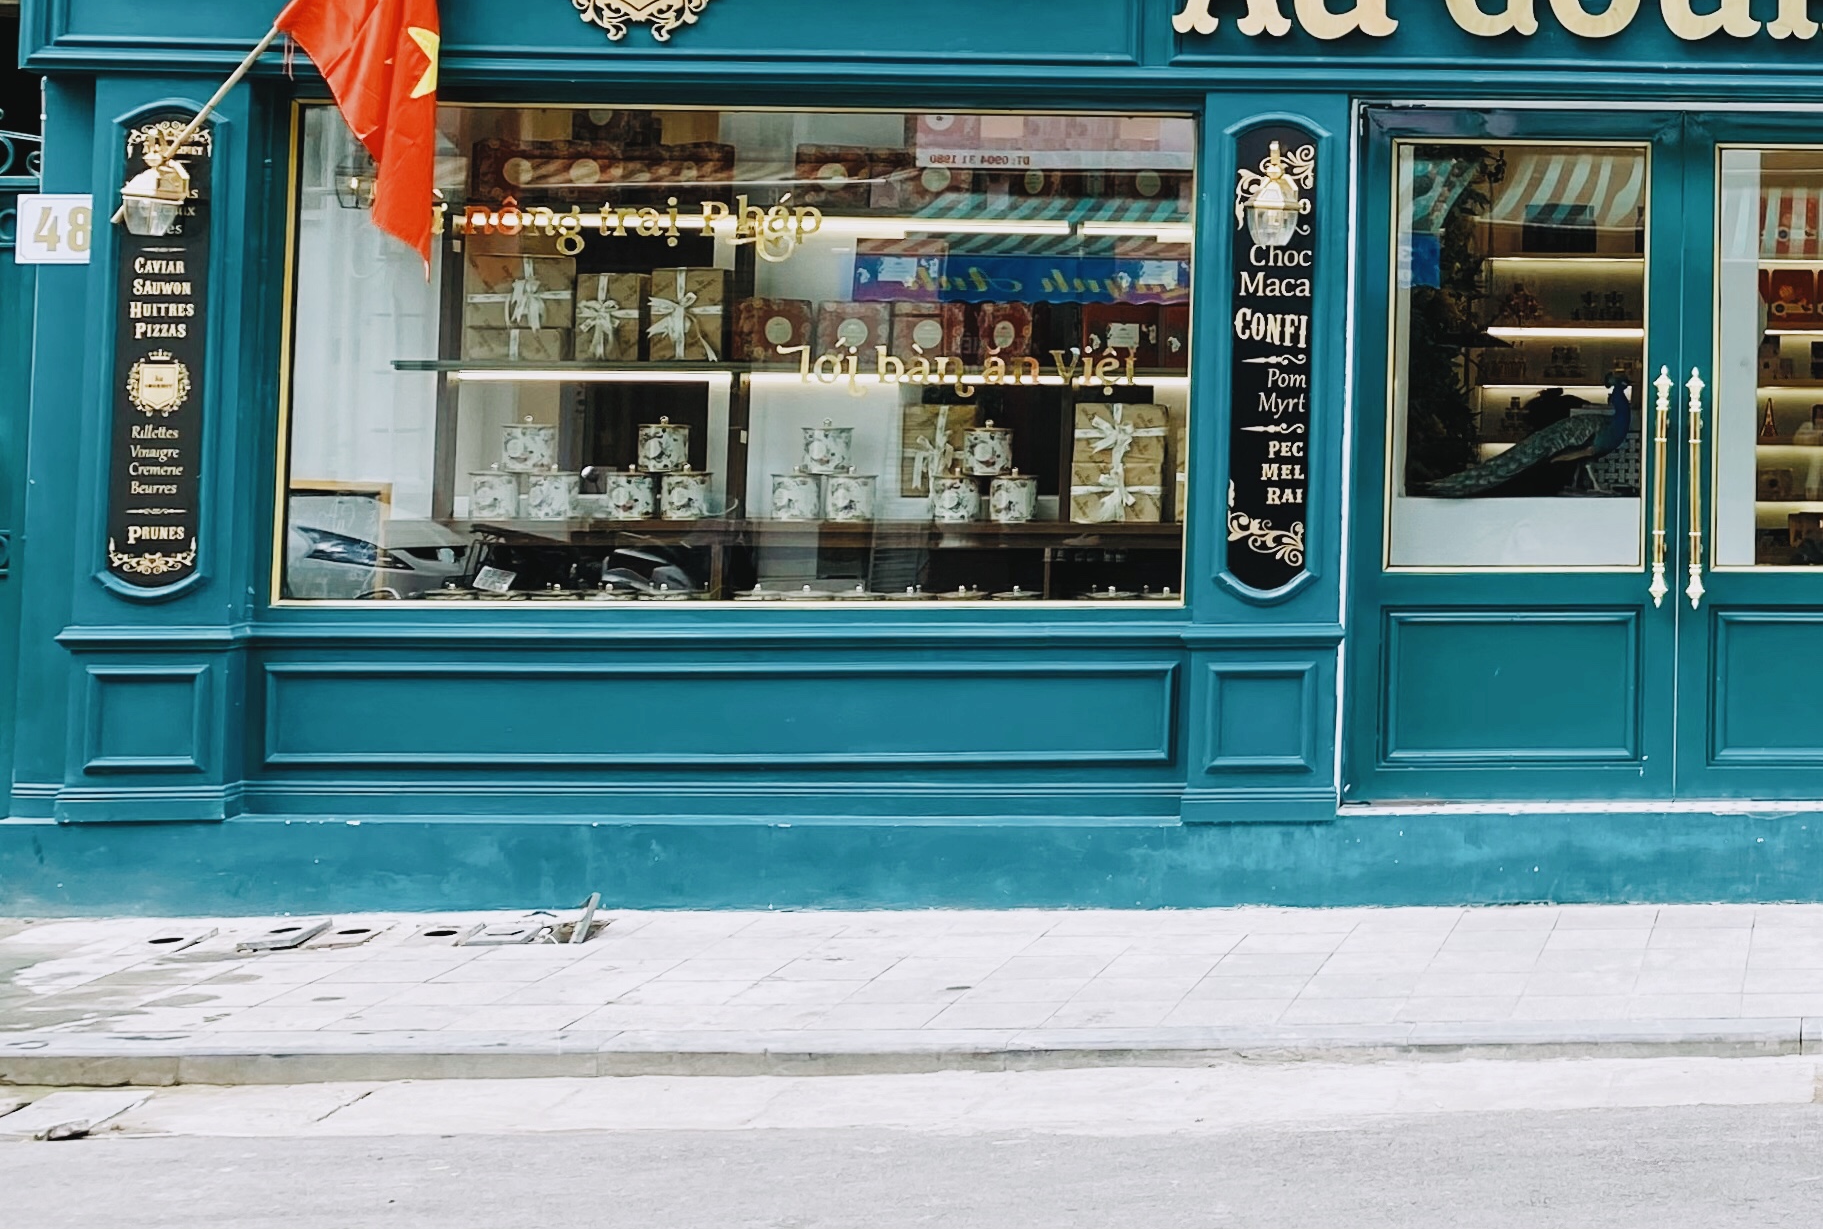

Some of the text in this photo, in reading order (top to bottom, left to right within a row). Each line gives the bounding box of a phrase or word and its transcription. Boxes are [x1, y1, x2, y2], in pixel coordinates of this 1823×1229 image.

[33, 206, 92, 252] 48
[464, 195, 585, 257] nông
[700, 192, 823, 262] Pháp
[1250, 245, 1312, 267] Choc
[134, 256, 185, 275] CAVIAR
[1239, 271, 1311, 297] Maca
[129, 301, 195, 319] HUITRES
[134, 322, 187, 339] PIZZAS
[1234, 307, 1308, 349] CONFI
[1267, 368, 1307, 388] Pom
[1258, 392, 1306, 418] Myrt
[131, 423, 179, 440] Rillettes
[129, 444, 180, 462] Vinaigre
[1268, 440, 1304, 458] PEC
[129, 462, 184, 476] Cremerie
[1260, 463, 1305, 481] MEL
[130, 480, 177, 495] Beurres
[1266, 487, 1303, 505] RAI
[127, 525, 185, 545] PRUNES
